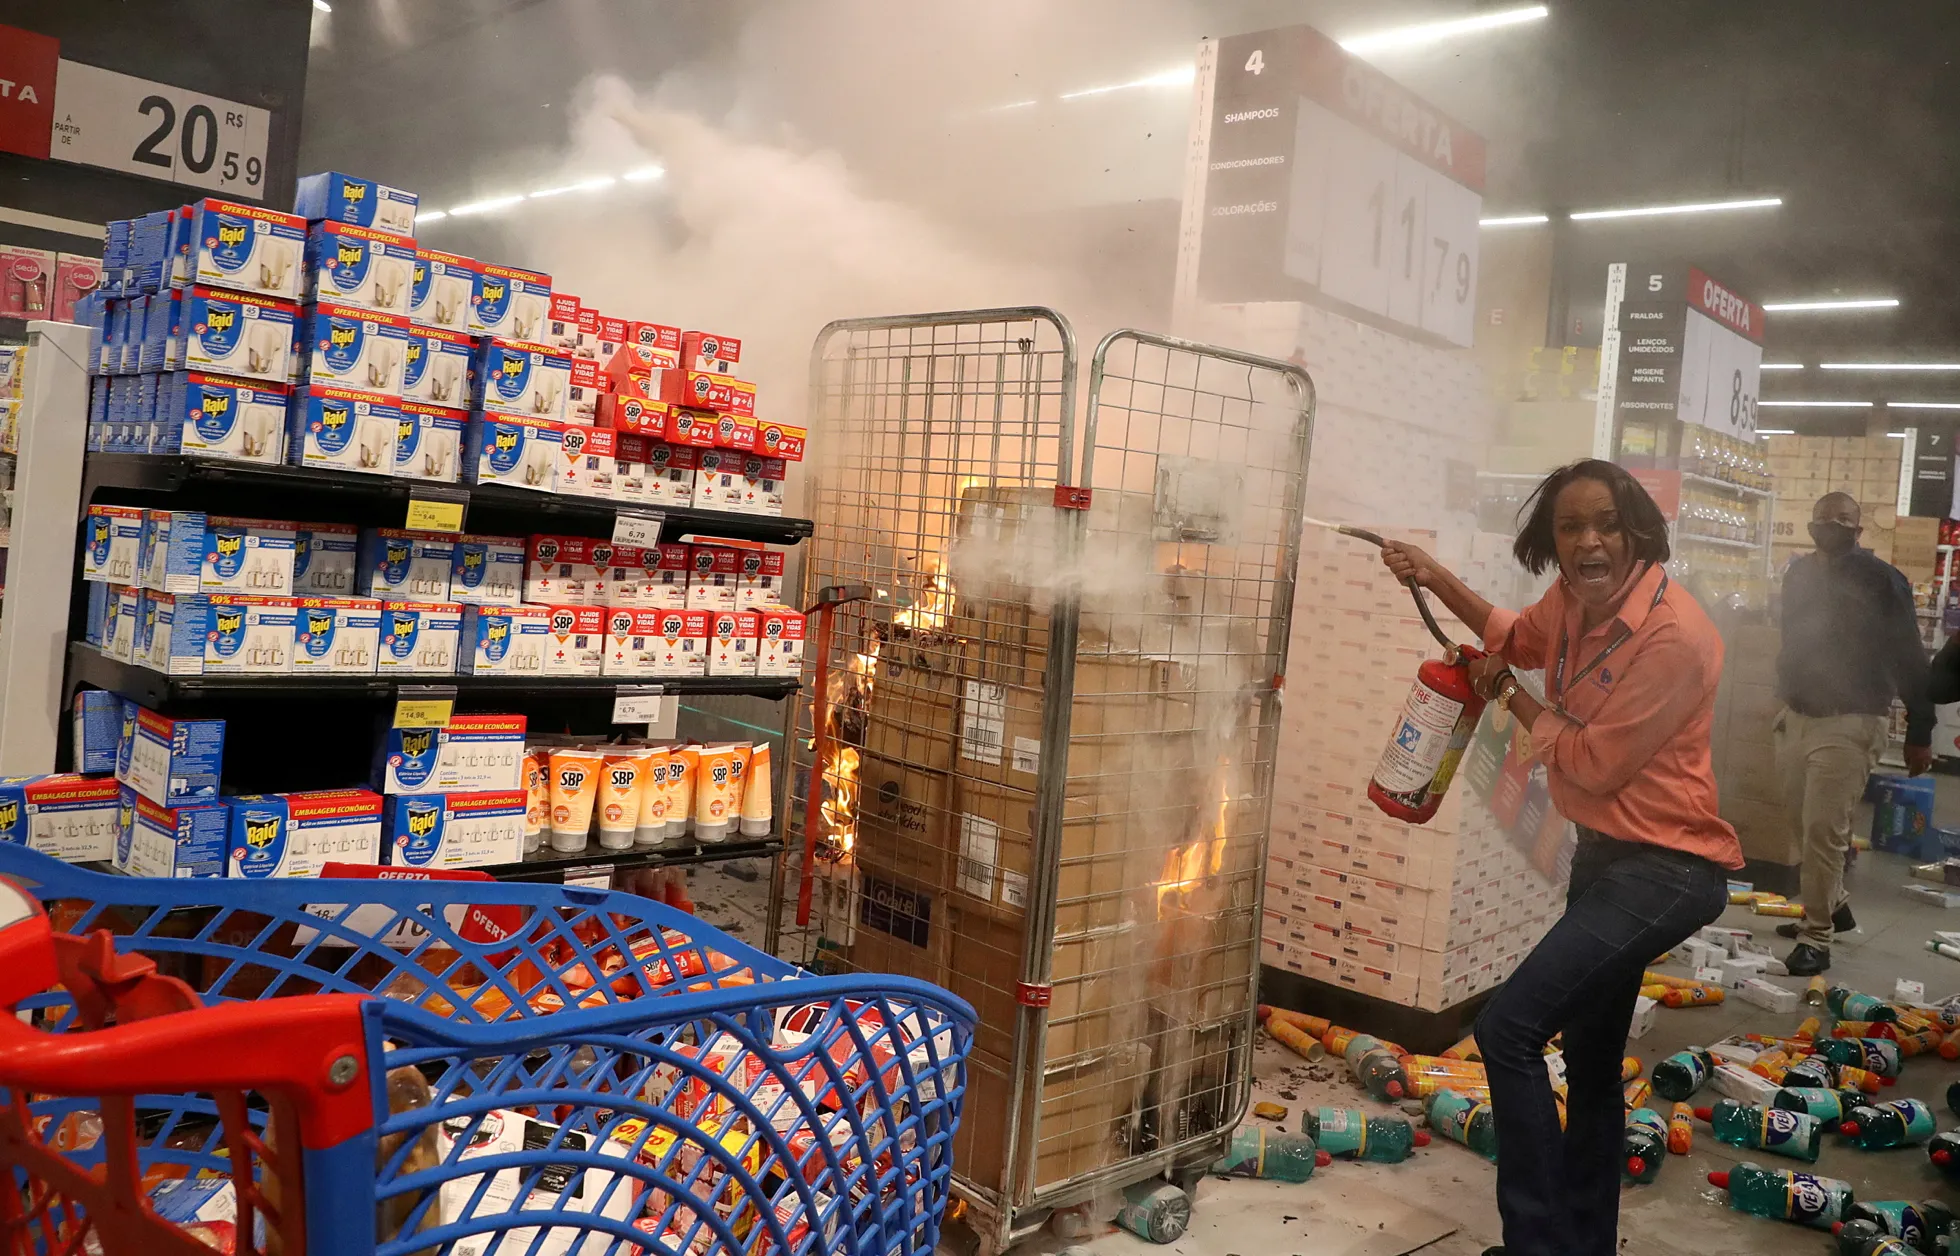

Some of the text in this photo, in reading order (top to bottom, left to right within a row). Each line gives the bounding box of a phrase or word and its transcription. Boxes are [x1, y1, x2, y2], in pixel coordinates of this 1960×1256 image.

[1245, 50, 1265, 75] 4
[66, 114, 72, 122] A
[225, 112, 243, 128] R$
[1224, 108, 1279, 123] SHAMPOOS
[55, 122, 80, 136] PARTIR
[132, 95, 218, 174] 20
[62, 135, 72, 145] DE
[1211, 156, 1284, 170] CONDICIONADORES
[343, 185, 365, 200] Raid
[221, 204, 287, 224] OFERTA ESPECIAL
[1212, 201, 1277, 216] COLORAÇÕES
[219, 226, 245, 243] Raid
[340, 226, 401, 244] OFERTA ESPECIAL
[338, 247, 362, 264] Raid
[431, 252, 459, 265] ESPECIAL
[15, 264, 38, 273] seda
[485, 266, 508, 277] OFERTA
[508, 270, 538, 283] ESPECIAL
[73, 272, 94, 281] seda
[1648, 275, 1662, 291] 5
[210, 290, 276, 308] OFERTA ESPECIAL
[482, 285, 504, 301] Raid
[556, 298, 576, 307] AJUDE
[556, 304, 576, 313] VIDAS
[1703, 279, 1750, 331] OFERTA
[208, 312, 235, 328] Raid
[333, 307, 393, 325] OFERTA ESPECIAL
[1630, 312, 1663, 320] FRALDAS
[331, 328, 354, 345] Raid
[427, 331, 455, 342] ESPECIAL
[640, 329, 656, 345] SBP
[660, 333, 677, 342] VIDAS
[1637, 339, 1667, 347] LENÇOS
[505, 341, 558, 356] OFERTA ESPECIAL
[703, 341, 718, 355] SBP
[722, 340, 738, 348] AJUDE
[722, 345, 738, 354] VIDAS
[503, 357, 524, 373] Raid
[575, 362, 595, 371] AJUDE
[1634, 368, 1664, 376] HIGIENE
[574, 369, 594, 378] VIDAS
[695, 380, 709, 393] SBP
[325, 388, 385, 404] OFERTA ESPECIAL
[1730, 369, 1742, 426] 8
[203, 397, 228, 413] Raid
[417, 405, 447, 417] ESPECIAL
[626, 404, 641, 419] SBP
[1620, 402, 1674, 410] ABSORVENTES
[323, 407, 346, 425] Raid
[498, 414, 550, 429] OFERTA ESPECIAL
[677, 417, 692, 431] SBP
[720, 420, 735, 434] SBP
[496, 431, 518, 448] Raid
[564, 433, 584, 450] SBP
[591, 431, 612, 440] AJUDE
[591, 437, 612, 447] VIDAS
[765, 430, 779, 445] SBP
[1931, 435, 1940, 445] 7
[652, 447, 669, 463] SBP
[702, 453, 720, 468] SBP
[745, 459, 762, 474] SBP
[217, 537, 241, 553] Raid
[539, 544, 557, 558] SBP
[593, 547, 611, 562] SBP
[643, 553, 661, 567] SBP
[696, 554, 713, 568] SBP
[744, 556, 760, 571] SBP
[210, 595, 231, 605] 50%
[303, 598, 321, 607] 50%
[388, 602, 405, 611] 50%
[483, 607, 499, 616] 50%
[579, 611, 600, 619] AJUDE
[637, 612, 656, 621] AJUDE
[217, 615, 240, 631] Raid
[309, 617, 330, 632] Raid
[554, 616, 573, 630] SBP
[579, 617, 600, 625] VIDAS
[613, 617, 631, 631] SBP
[637, 618, 656, 627] VIDAS
[664, 620, 681, 634] SBP
[687, 616, 704, 624] AJUDE
[687, 621, 704, 630] VIDAS
[739, 617, 755, 625] AJUDE
[739, 622, 755, 631] VIDAS
[787, 618, 802, 627] AJUDE
[394, 621, 414, 637] Raid
[488, 626, 507, 640] Raid
[718, 621, 734, 635] SBP
[767, 622, 783, 637] SBP
[787, 624, 802, 633] VIDAS
[483, 721, 520, 731] ECONÔMICA
[403, 732, 431, 753] Raid
[561, 771, 584, 787] SBP
[612, 770, 634, 785] SBP
[654, 767, 666, 782] SBP
[713, 767, 728, 782] SBP
[32, 787, 119, 801] EMBALAGEM ECONÔMICA
[451, 796, 521, 808] EMBALAGEM ECONÔMICA
[294, 803, 376, 817] EMBALAGEM ECONÔMICA
[409, 812, 436, 832] Raid
[247, 820, 277, 844] Raid
[473, 908, 509, 941] OFERT
[1778, 1108, 1791, 1130] VEJA
[1804, 1181, 1818, 1210] VEJA
